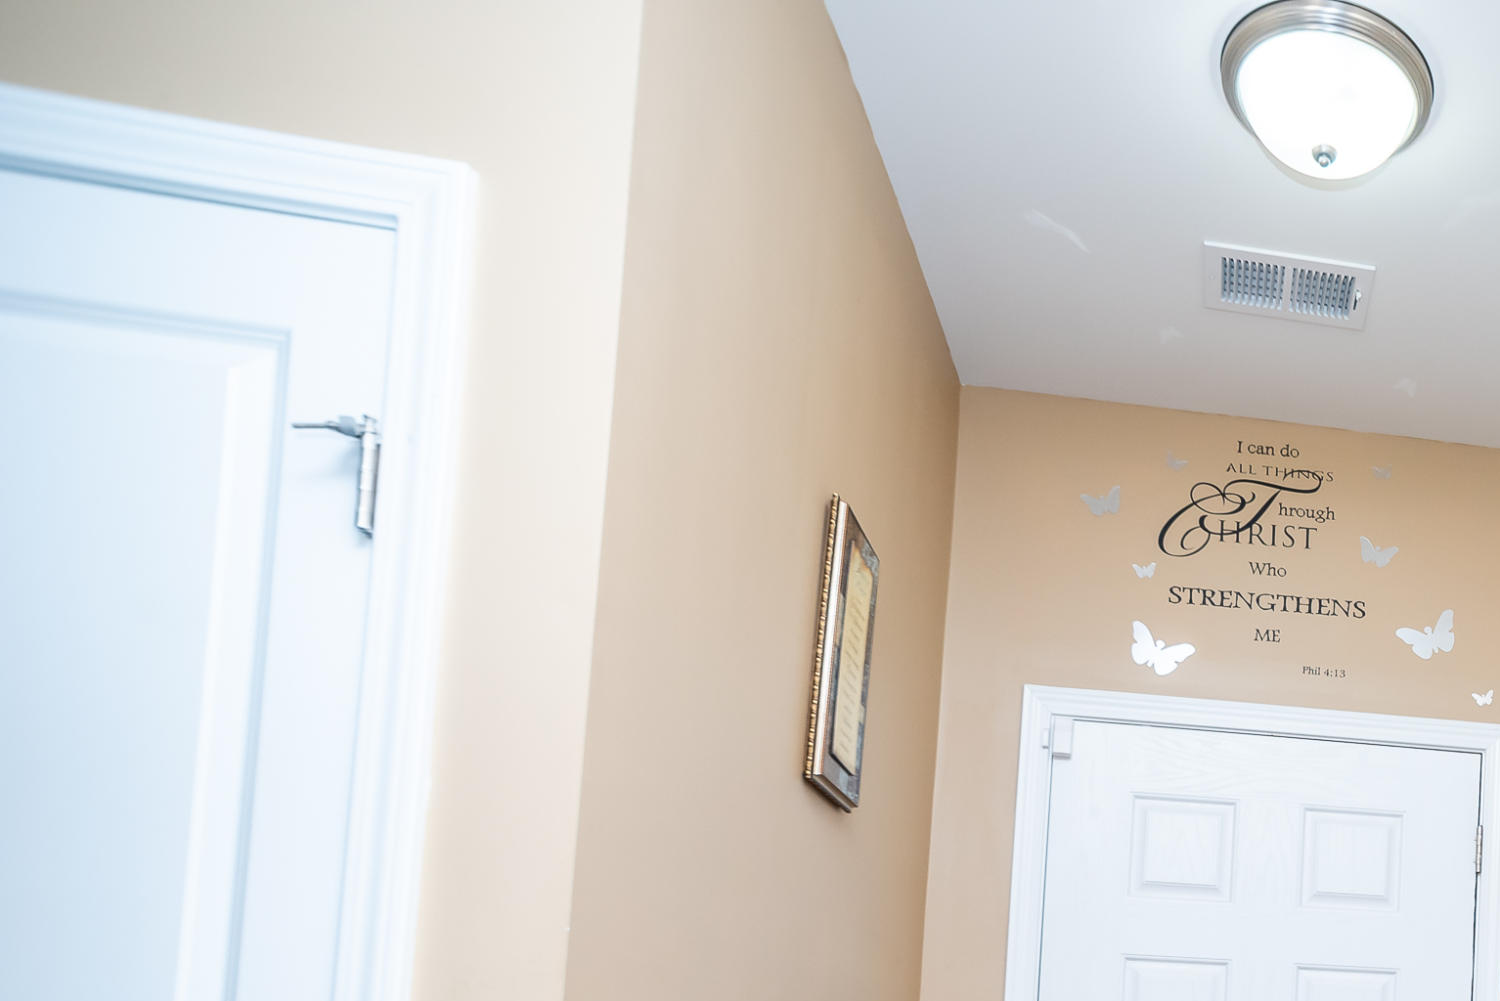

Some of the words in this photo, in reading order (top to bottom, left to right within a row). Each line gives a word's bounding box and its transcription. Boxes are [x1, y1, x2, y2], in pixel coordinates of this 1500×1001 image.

[1236, 440, 1243, 453] I
[1248, 443, 1275, 456] can
[1280, 444, 1300, 458] do
[1226, 463, 1257, 475] ALL
[1262, 465, 1334, 482] THINGS
[1158, 482, 1318, 557] CHRIST
[1248, 561, 1287, 577] Who
[1168, 585, 1366, 618] STRENGTHENS
[1254, 628, 1281, 643] ME
[1302, 666, 1321, 676] Phil
[1323, 667, 1346, 678] 4:13
